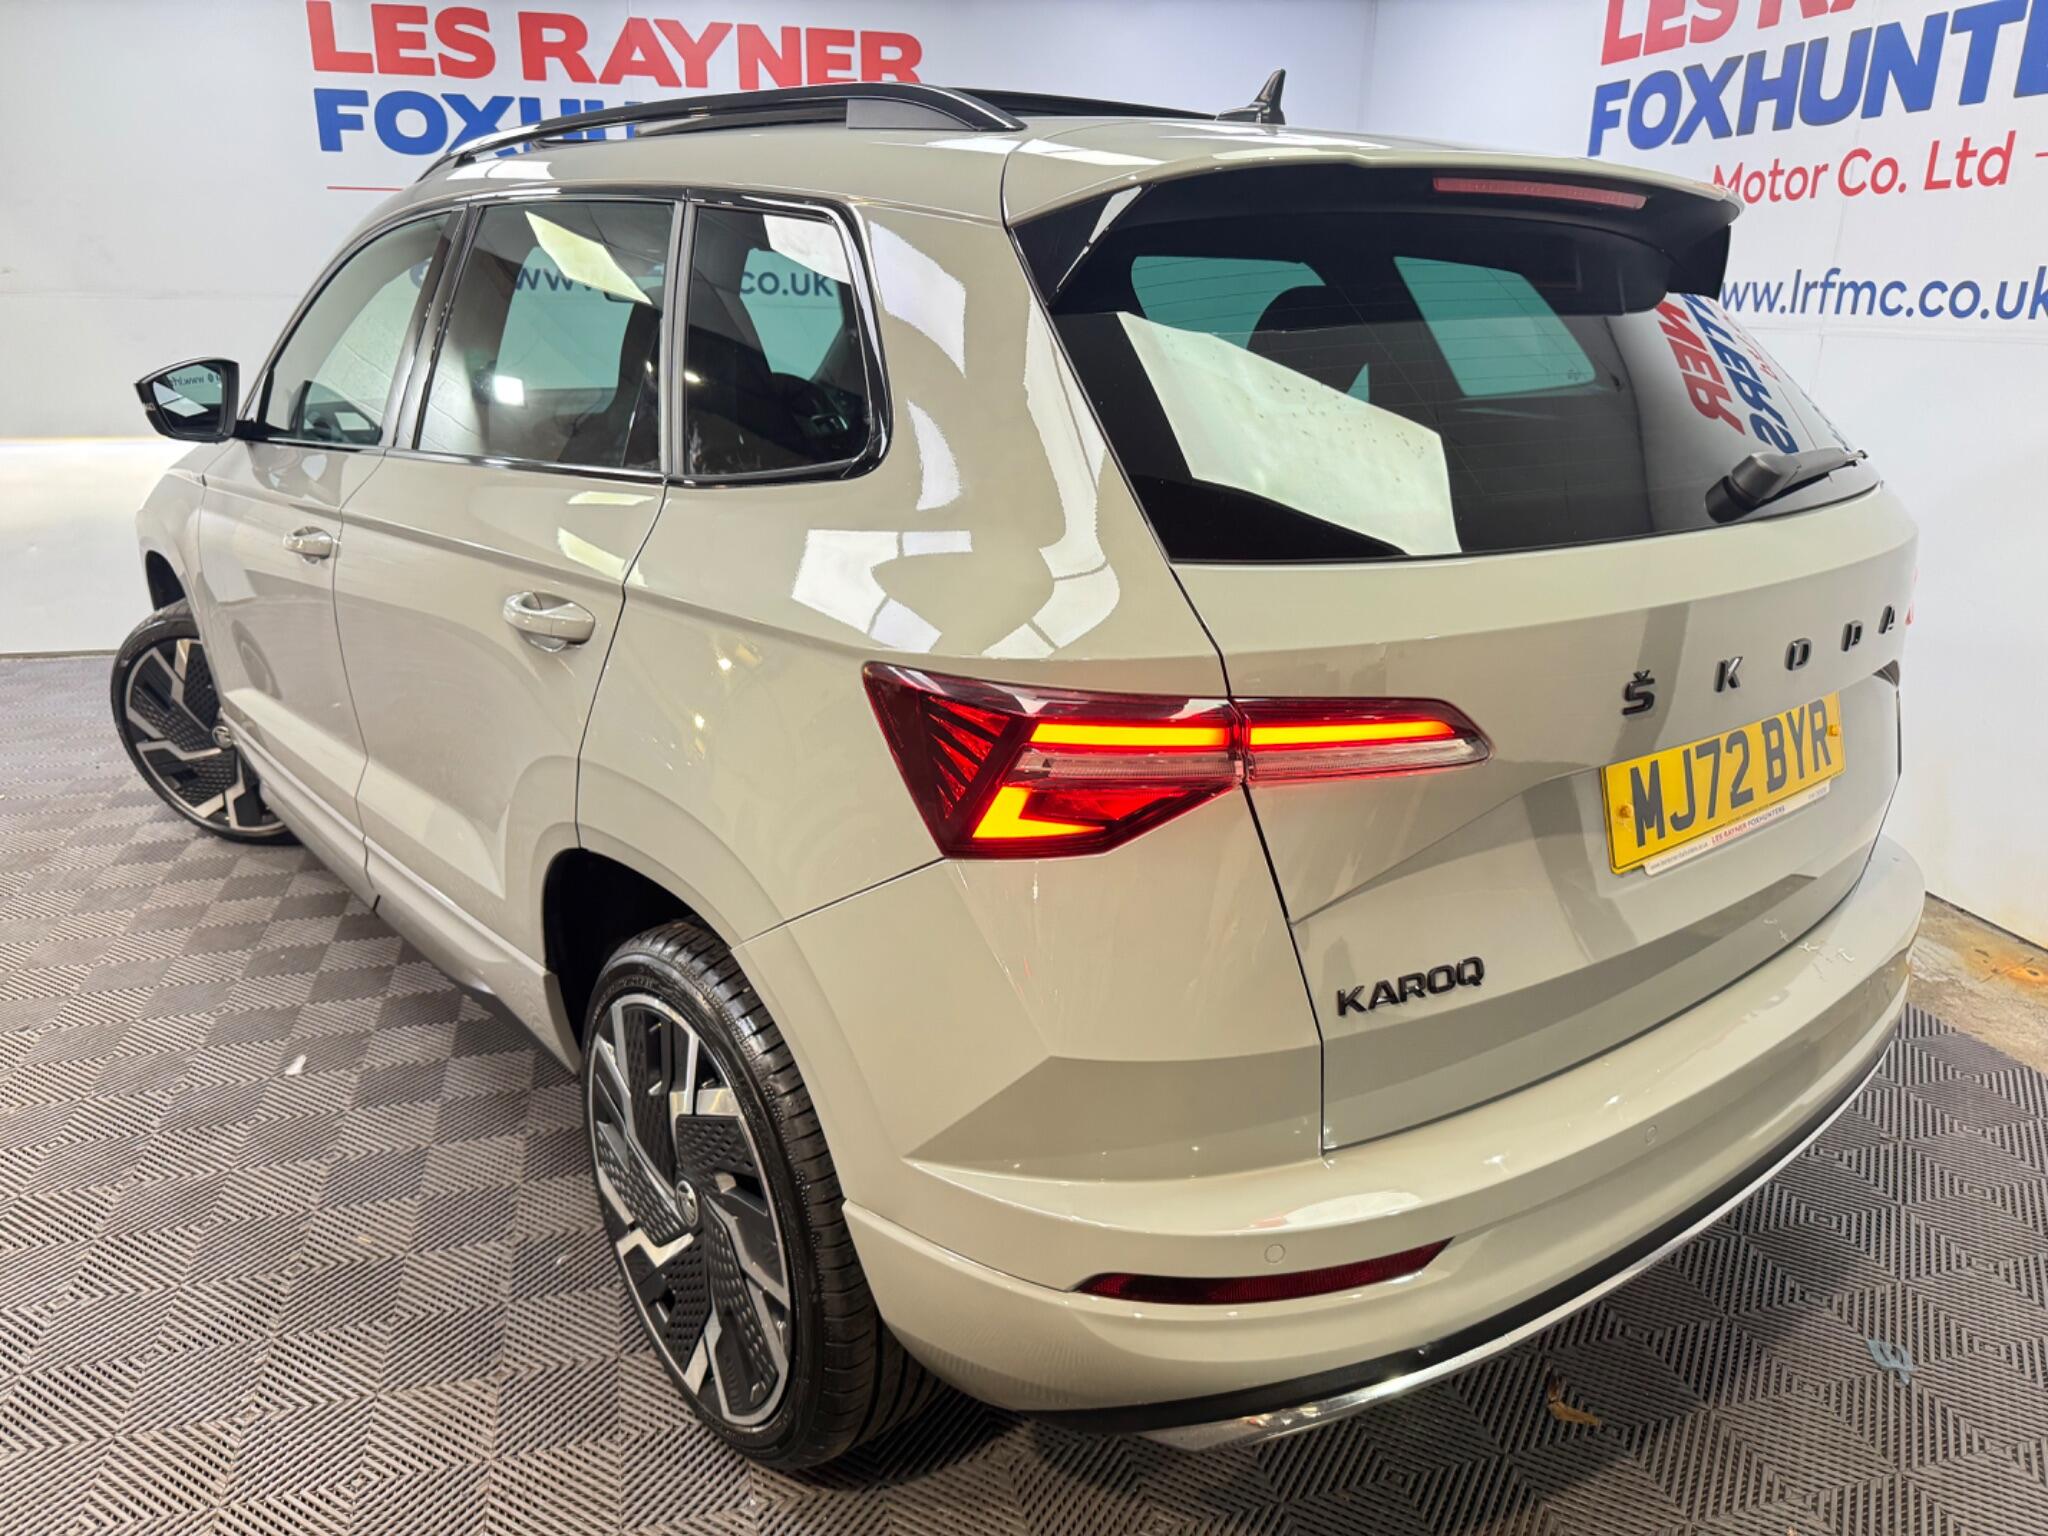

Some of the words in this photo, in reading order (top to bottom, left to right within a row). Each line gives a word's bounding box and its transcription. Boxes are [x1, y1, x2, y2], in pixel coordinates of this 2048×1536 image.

[306, 1, 496, 80] LES
[517, 12, 922, 90] RAYNER
[1601, 0, 1740, 65] LES
[1713, 159, 1829, 204] Motor
[1838, 147, 1908, 197] Co.
[1924, 130, 2017, 190] Ltd
[1629, 728, 1755, 848] MJ72
[1761, 698, 1832, 796] BYR
[1336, 956, 1485, 1017] KAROQ
